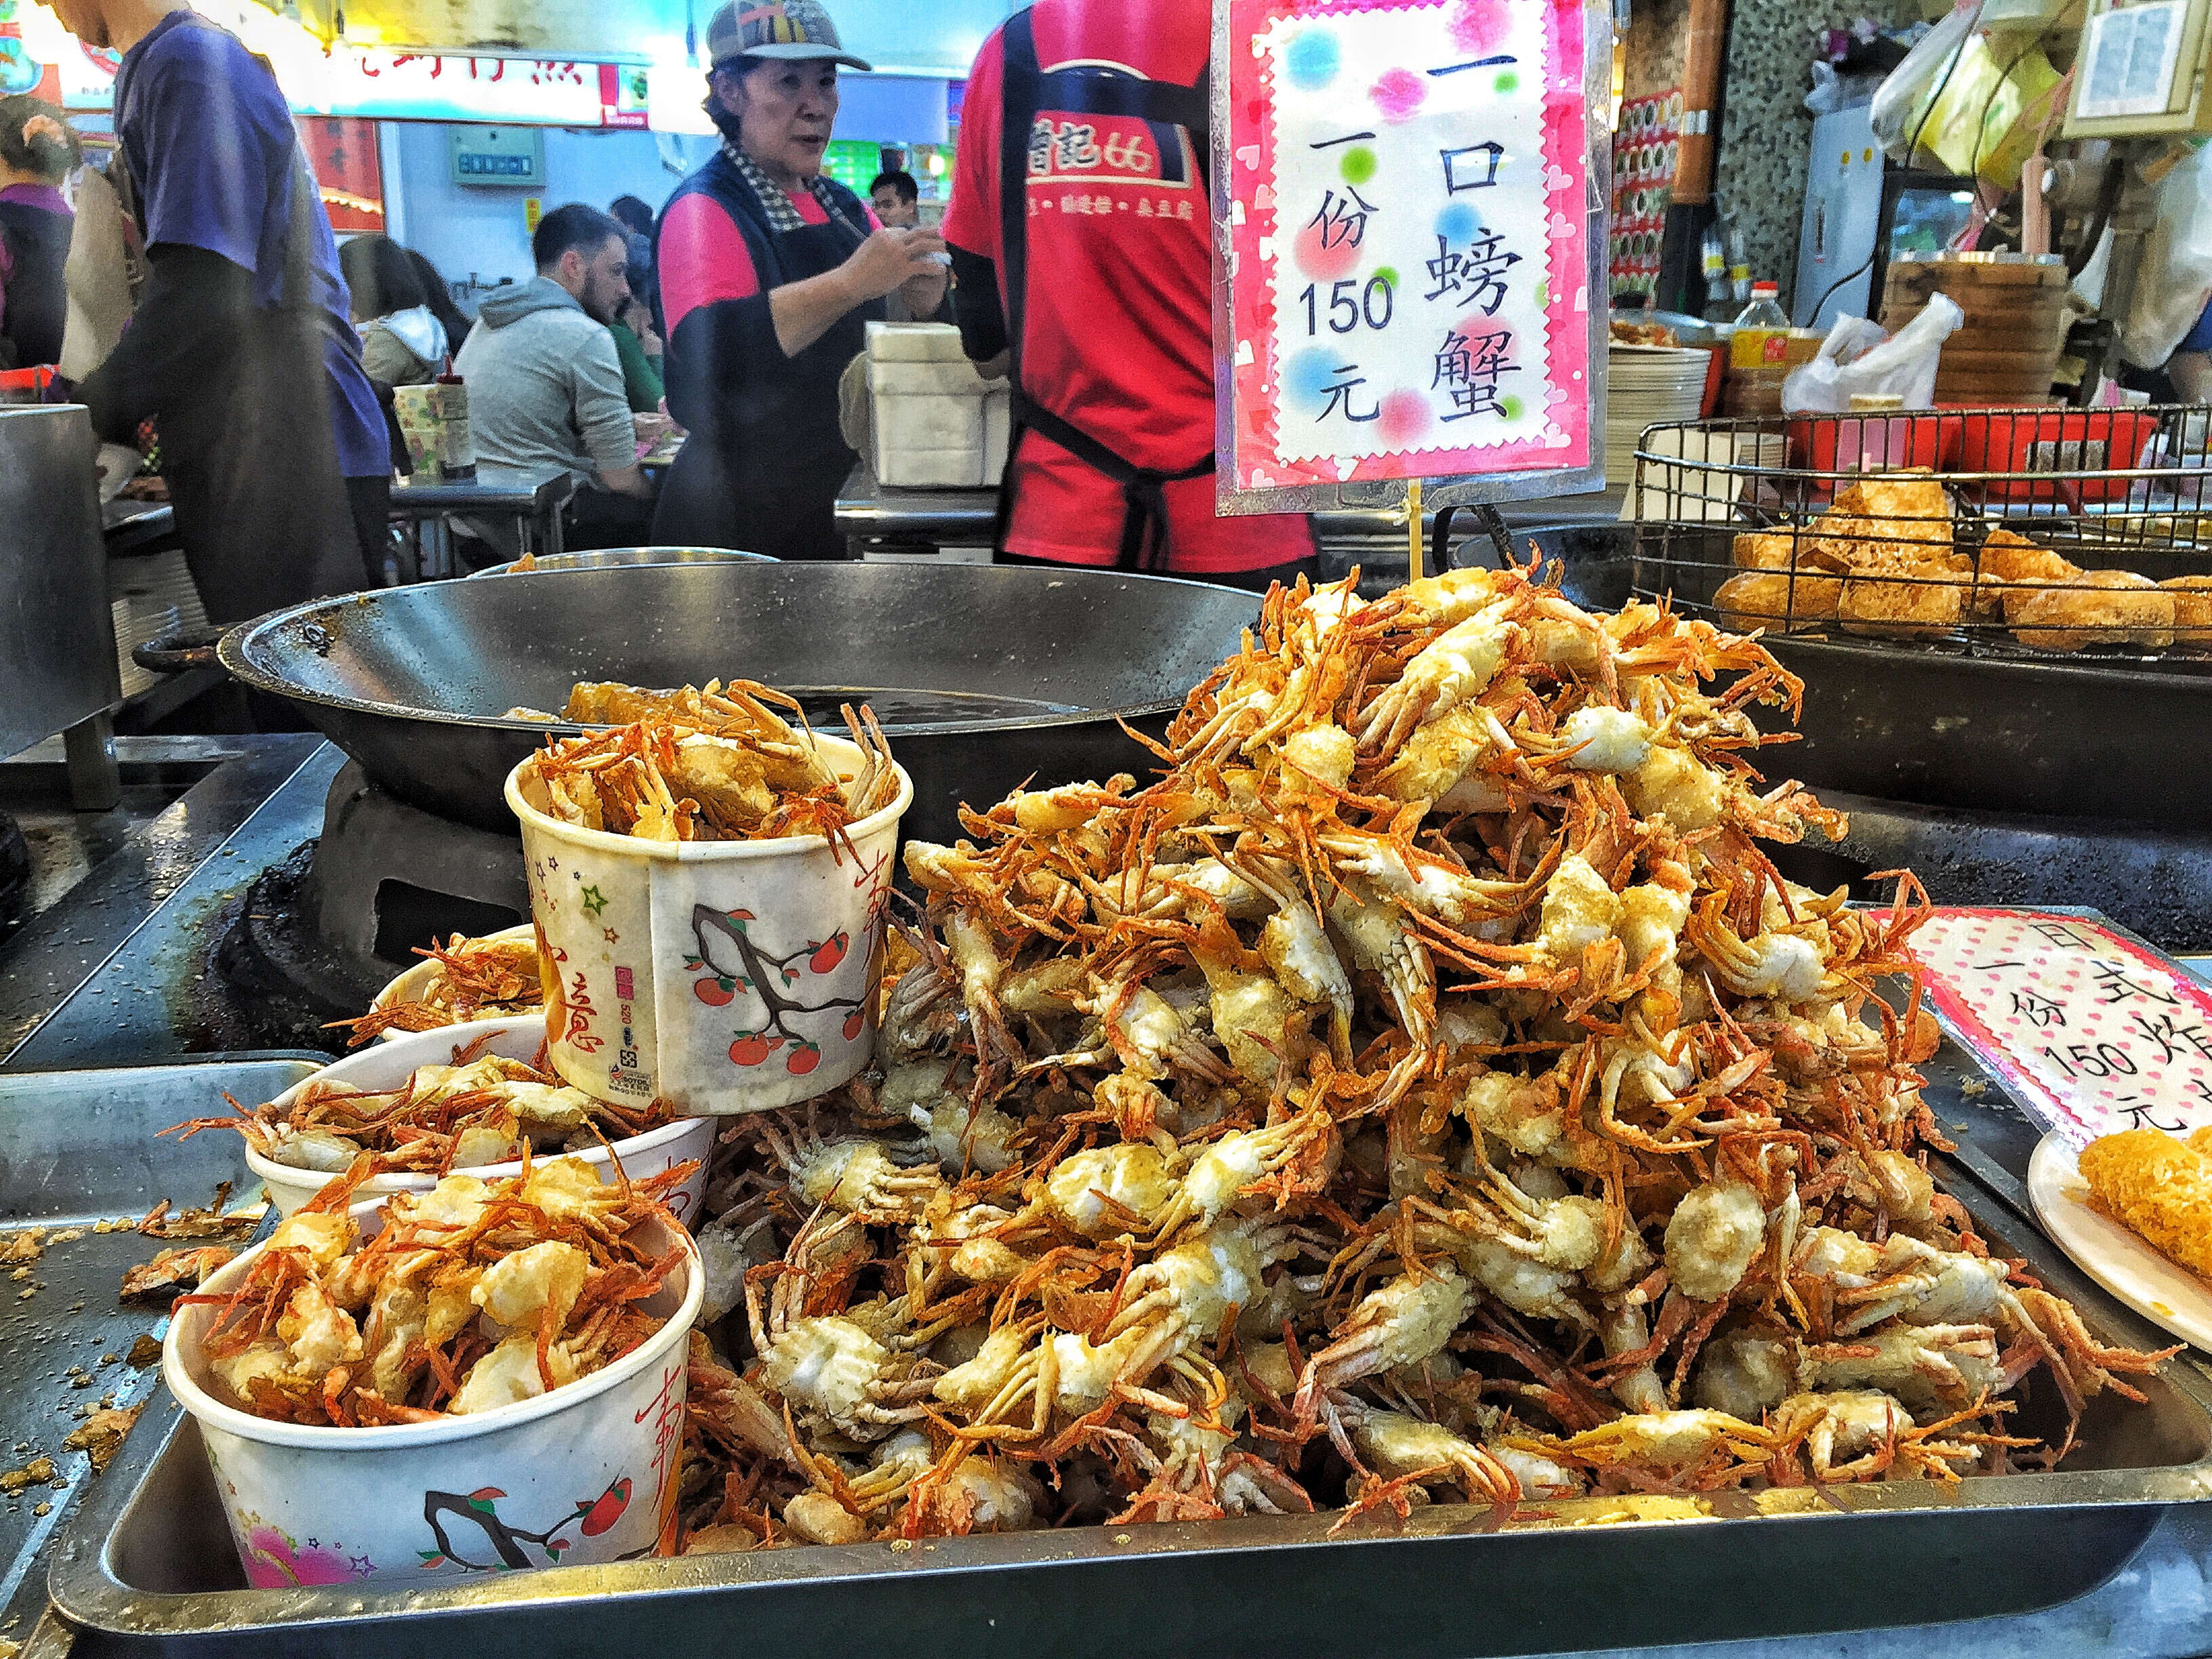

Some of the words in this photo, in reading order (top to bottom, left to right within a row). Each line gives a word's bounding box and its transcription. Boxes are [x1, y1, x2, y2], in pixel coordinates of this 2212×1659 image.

[1299, 131, 1395, 425] 一份150元
[1423, 55, 1523, 424] 一口螃蟹
[1973, 962, 2188, 1131] 一份150元
